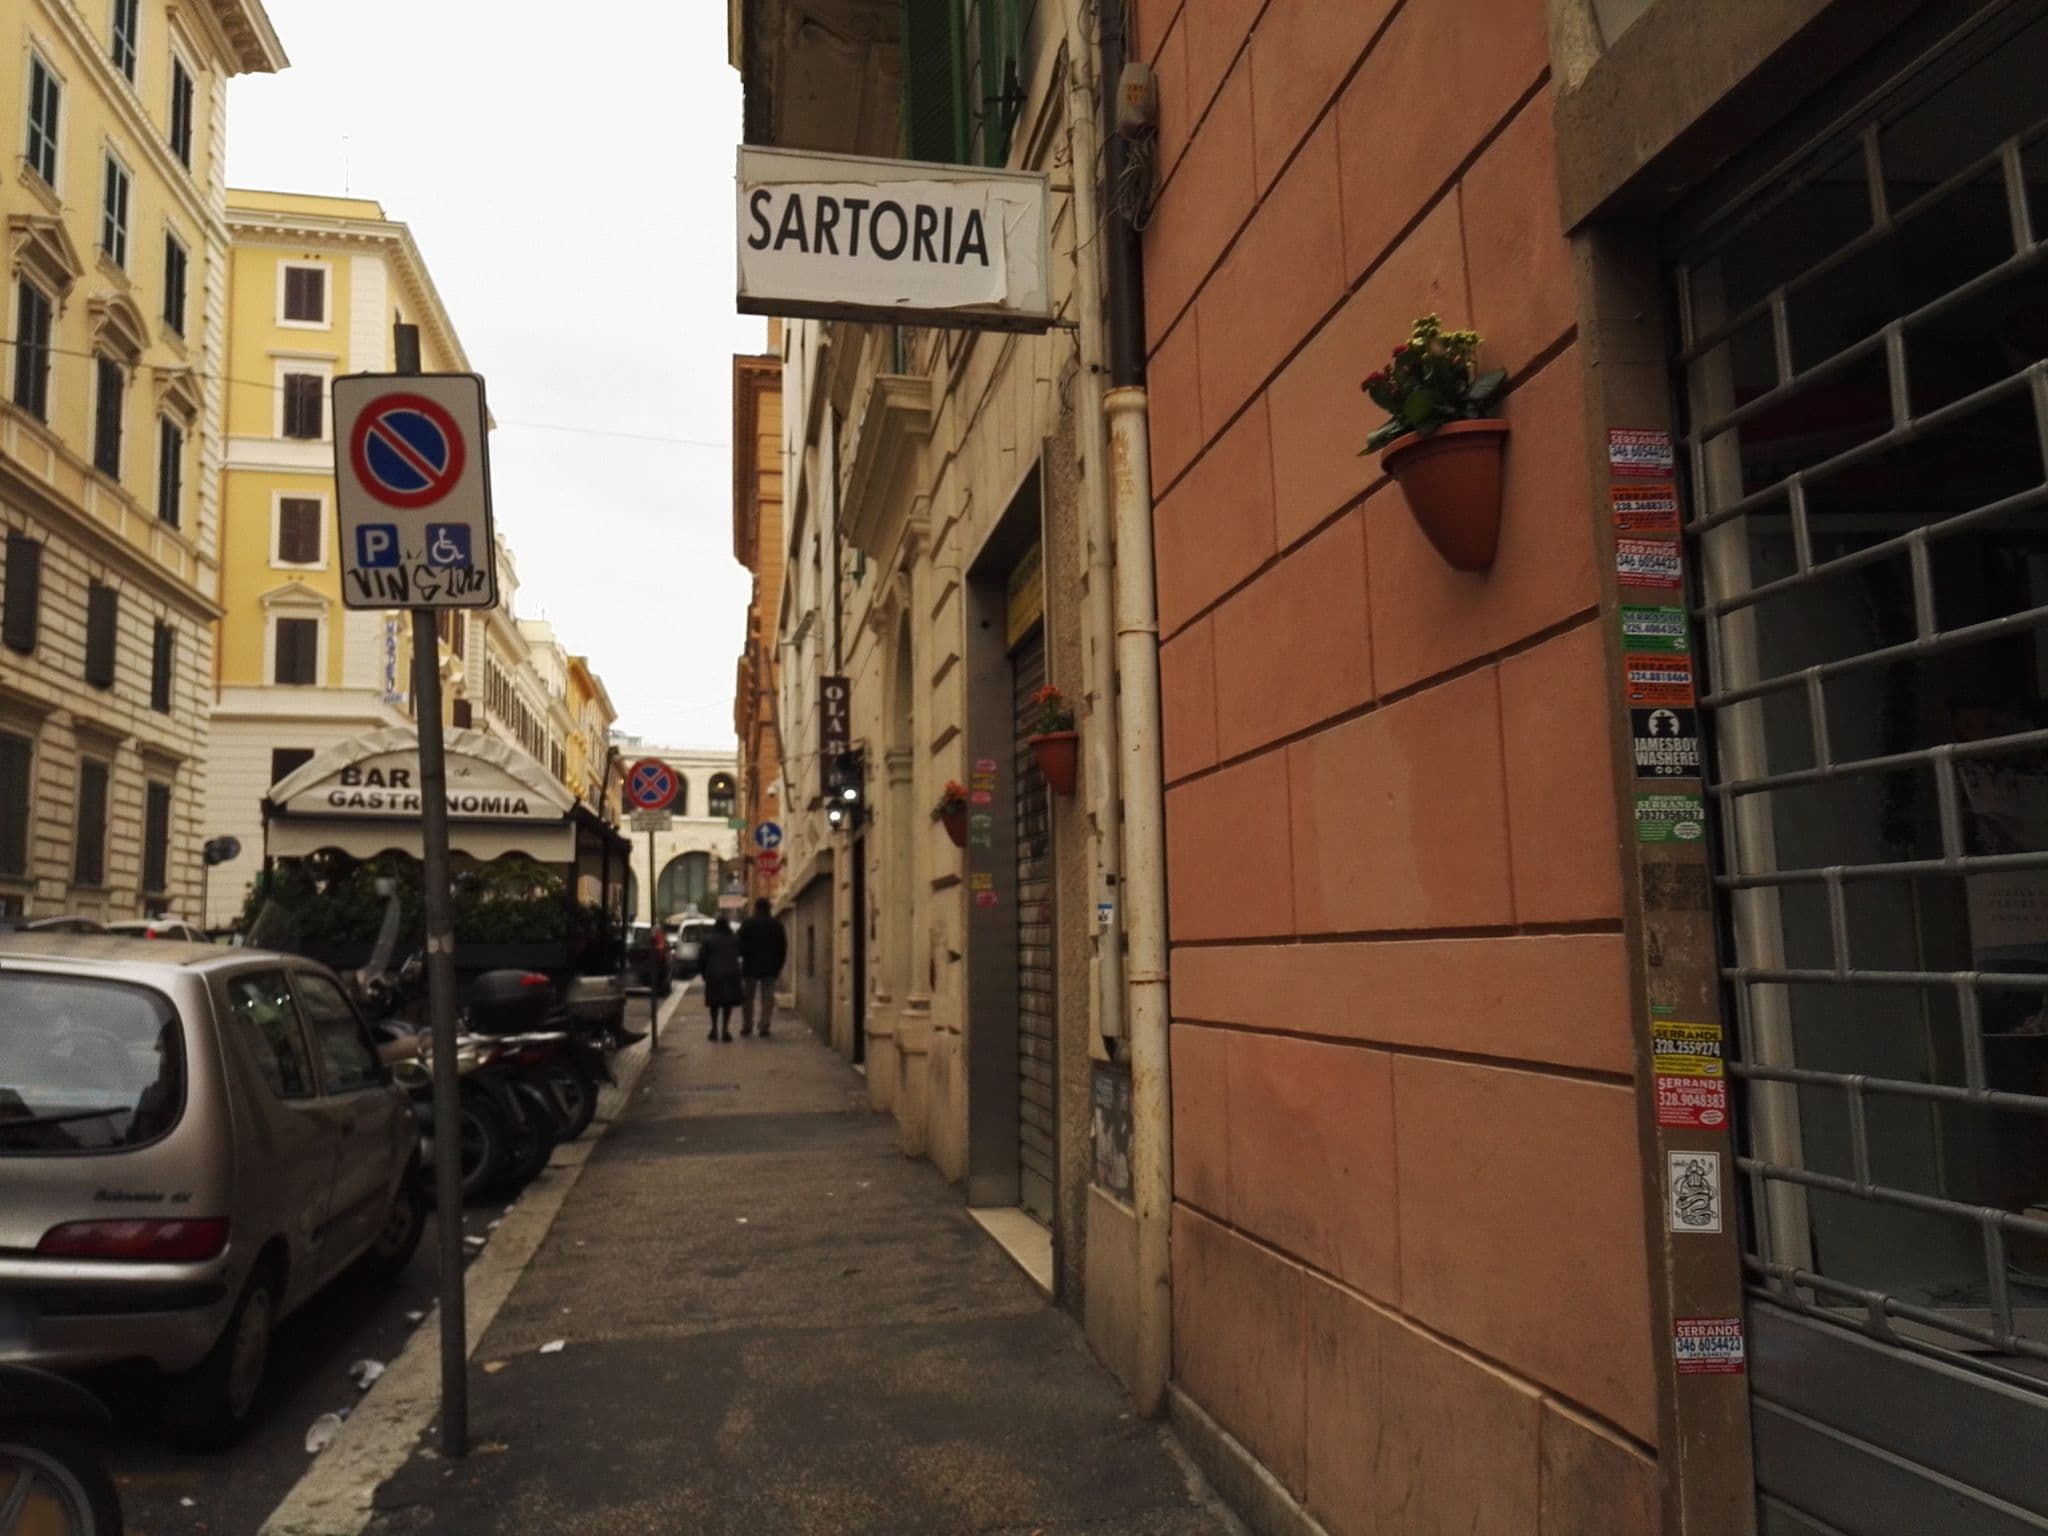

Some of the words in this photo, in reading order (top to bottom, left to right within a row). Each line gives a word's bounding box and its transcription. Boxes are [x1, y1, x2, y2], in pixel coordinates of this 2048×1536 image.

[747, 189, 989, 267] SARTORIA
[1610, 434, 1669, 446] SERRANDE
[364, 529, 390, 563] P
[1618, 543, 1677, 556] SERRANDE
[340, 767, 410, 788] BAR
[327, 790, 529, 815] GASTRNOMIA
[1637, 800, 1701, 809] SERRANDE
[1655, 1028, 1719, 1041] SERRANDE
[1658, 1077, 1726, 1093] SERRANDE
[1677, 1325, 1740, 1337] SERRANDE
[1677, 1337, 1696, 1352] 346
[1699, 1336, 1741, 1352] 6054423
